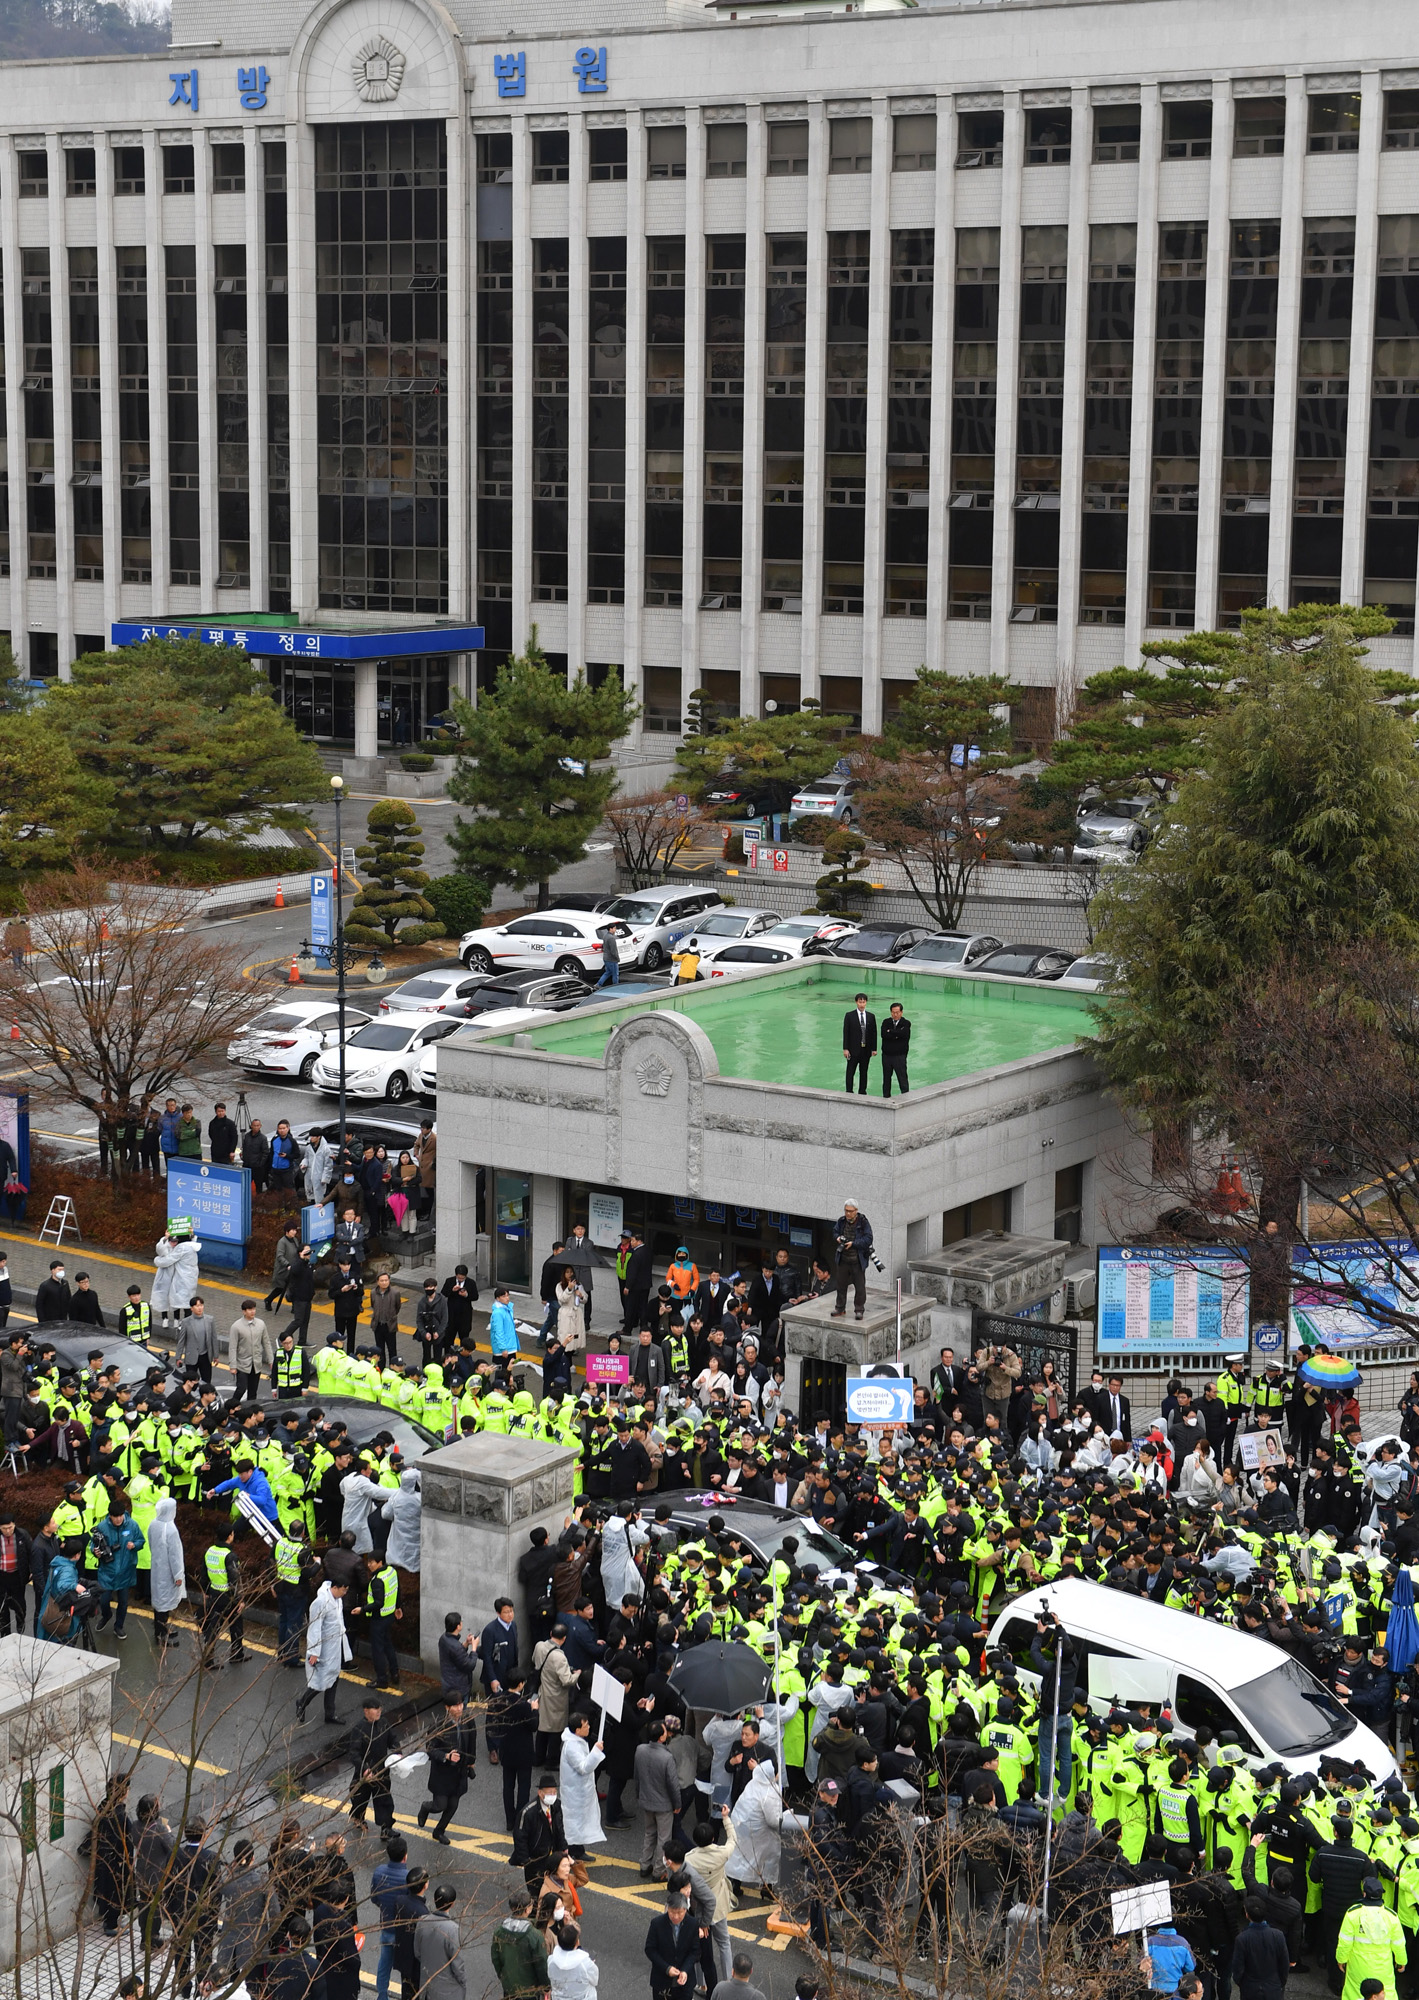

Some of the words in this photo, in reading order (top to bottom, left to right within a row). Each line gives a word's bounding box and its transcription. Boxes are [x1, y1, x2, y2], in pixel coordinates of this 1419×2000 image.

[168, 66, 271, 111] 지방
[494, 46, 609, 97] 법원
[208, 630, 250, 650] 평등
[278, 634, 320, 652] 정의
[314, 878, 326, 895] P
[531, 943, 546, 952] KBS
[192, 1180, 231, 1198] 고등법원
[192, 1199, 231, 1216] 지방법원
[1259, 1333, 1279, 1344] ADT
[606, 1364, 624, 1372] 주범은
[989, 1731, 1013, 1743] 경찰
[989, 1740, 1013, 1750] POLICE
